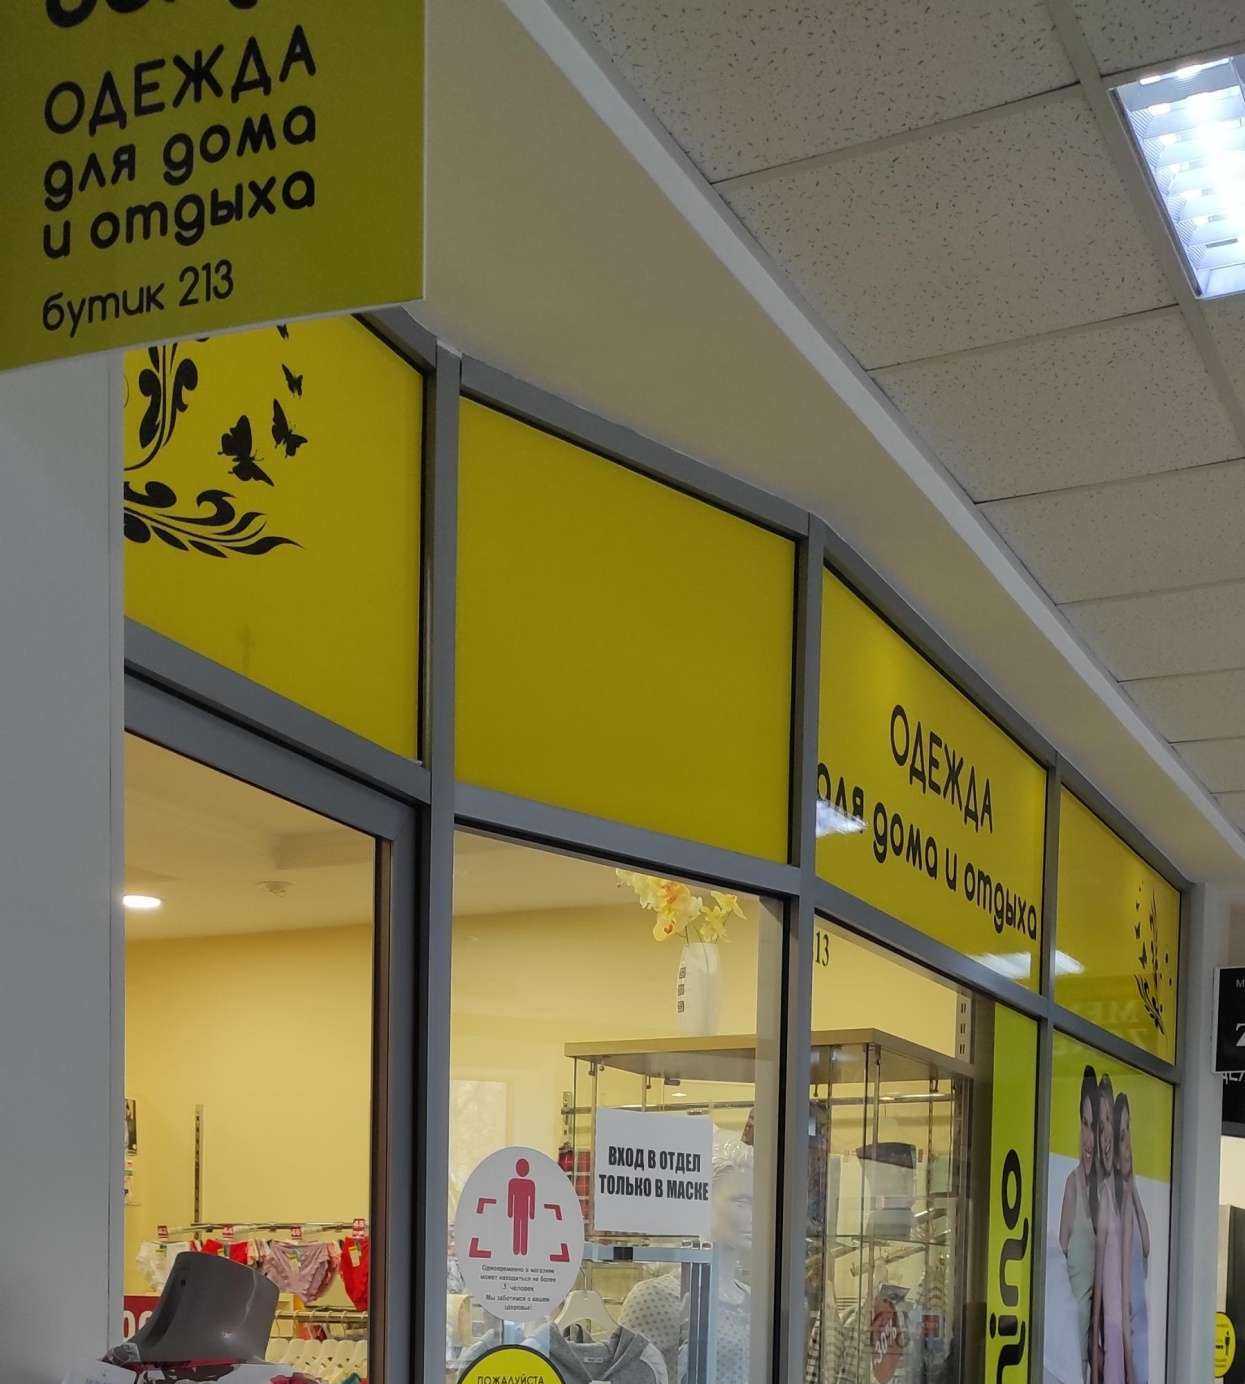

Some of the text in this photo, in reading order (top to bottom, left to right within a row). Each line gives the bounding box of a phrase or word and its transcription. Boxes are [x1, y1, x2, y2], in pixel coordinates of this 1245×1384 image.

[44, 25, 316, 137] ОДЕЖДА
[43, 105, 316, 212] для дома
[43, 170, 316, 259] и отдыха
[42, 260, 234, 338] бутик 213
[890, 704, 993, 834] ОДЕЖДА
[873, 802, 938, 881] дома
[944, 847, 957, 893] и
[964, 862, 1038, 940] отдыха
[599, 1174, 709, 1201] ТОЛЬКО В МАСКЕ
[608, 1145, 701, 1174] ВХОД В ОТДЕЛ
